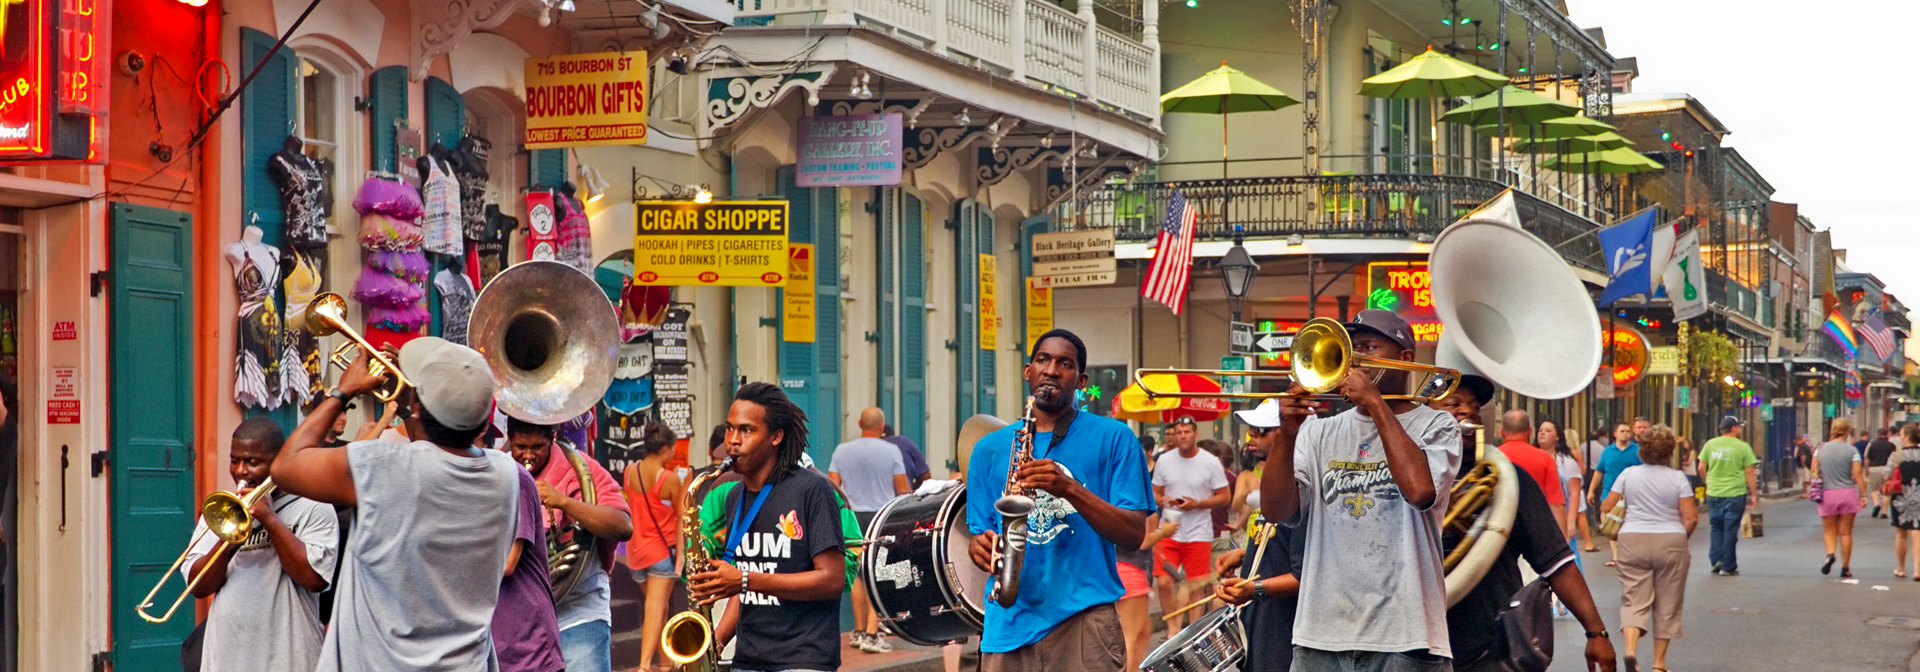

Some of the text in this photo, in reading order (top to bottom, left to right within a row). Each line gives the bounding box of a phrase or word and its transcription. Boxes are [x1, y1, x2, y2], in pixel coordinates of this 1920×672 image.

[538, 57, 632, 75] 715 BOURBON ST
[527, 80, 643, 118] BOURBON GIFTS
[527, 124, 644, 142] LOWEST PRICE GUARANTEED
[540, 220, 547, 231] 2
[641, 209, 781, 231] CIGAR SHOPPE
[639, 240, 783, 251] HOOKAH PIPES CIGARETTES
[1036, 238, 1111, 251] Black Heritage Gallery
[651, 255, 769, 266] COLD DRINKS T-SHIRTS
[54, 321, 75, 331] ATM
[1271, 338, 1289, 347] ONE
[660, 402, 690, 411] JESUS
[661, 411, 690, 419] LOVES
